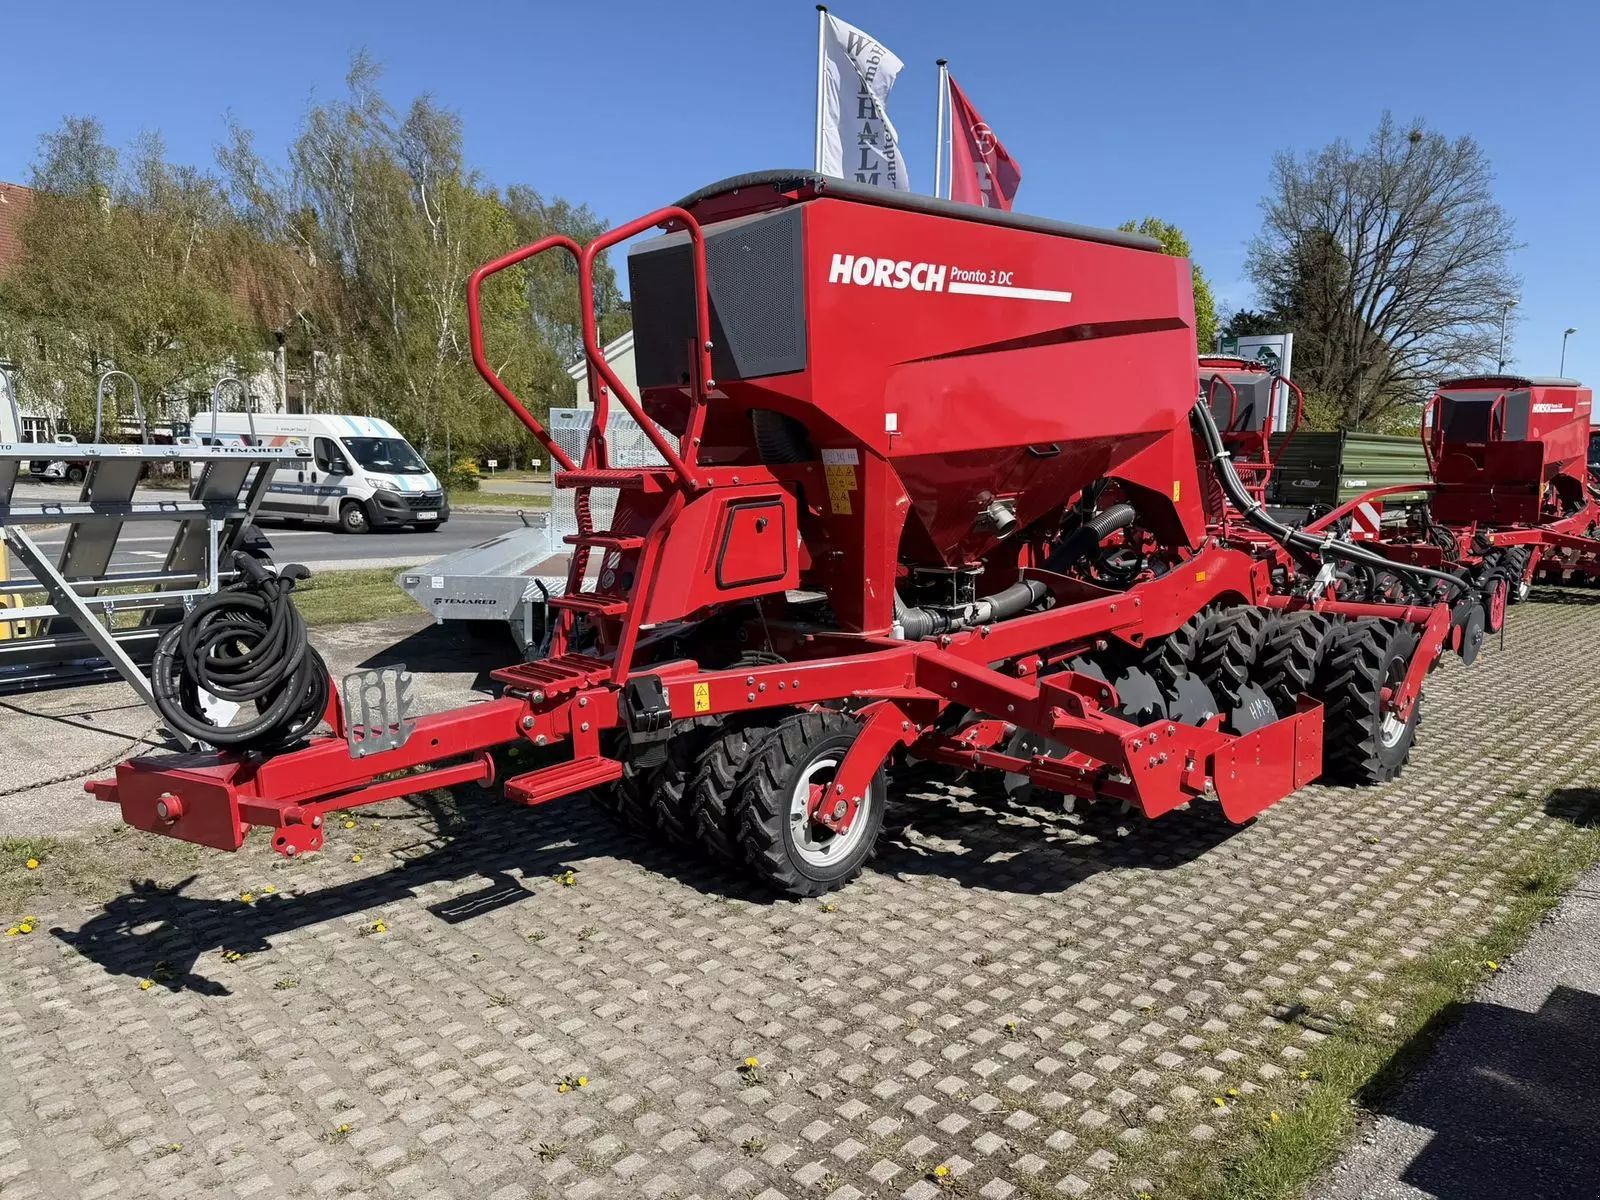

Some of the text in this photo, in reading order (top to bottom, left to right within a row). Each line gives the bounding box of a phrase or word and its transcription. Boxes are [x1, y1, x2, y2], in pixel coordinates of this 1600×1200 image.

[828, 253, 1014, 292] HORSCH Pronto 3 DC
